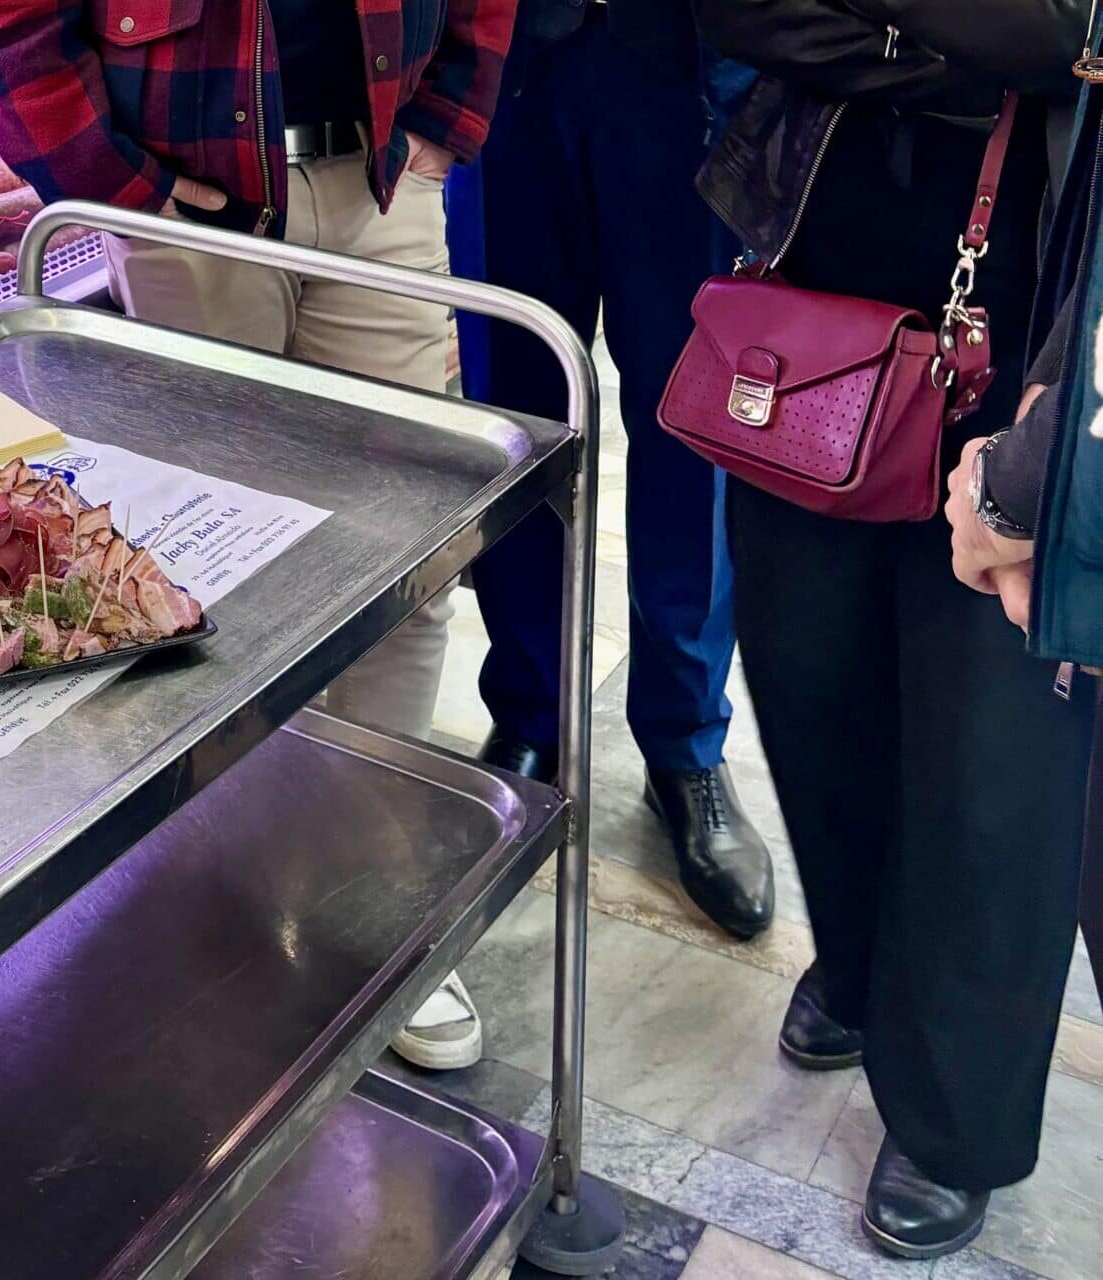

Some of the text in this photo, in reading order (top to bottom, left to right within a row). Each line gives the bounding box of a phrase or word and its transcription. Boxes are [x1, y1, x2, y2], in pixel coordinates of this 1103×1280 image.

[159, 539, 199, 566] Jacky
[192, 520, 225, 540] Bula
[221, 507, 242, 519] SA
[67, 675, 84, 689] 022
